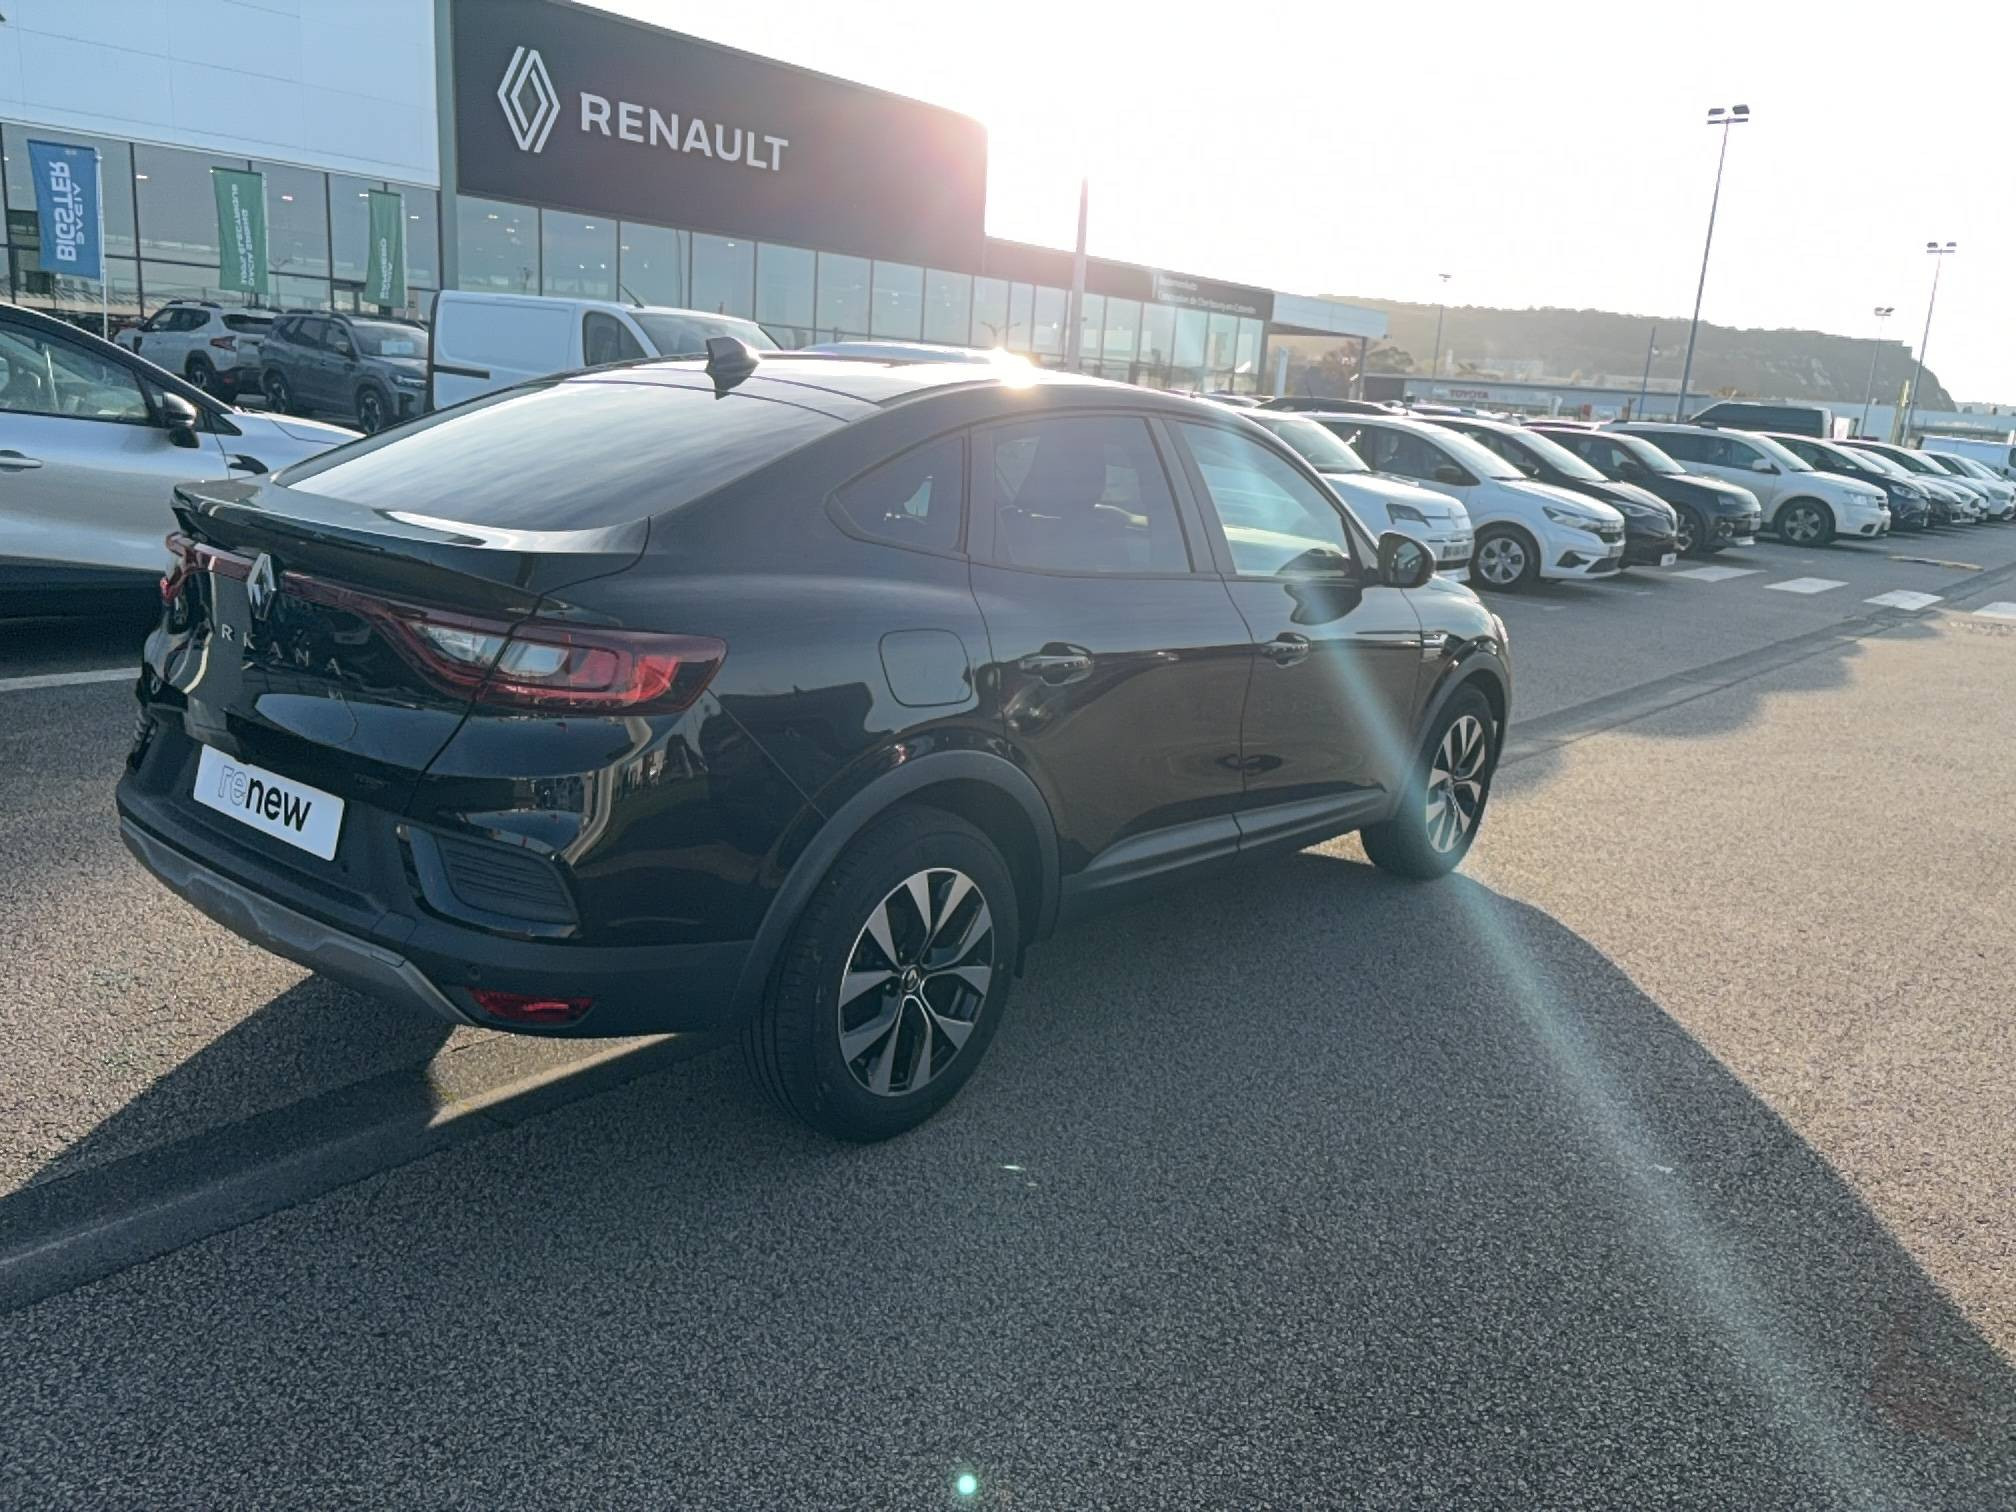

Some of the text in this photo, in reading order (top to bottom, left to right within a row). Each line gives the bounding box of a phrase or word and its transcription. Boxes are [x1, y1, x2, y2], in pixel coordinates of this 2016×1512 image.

[580, 92, 789, 171] RENAULT
[1450, 389, 1489, 399] TOYOTA
[217, 765, 313, 832] renew
